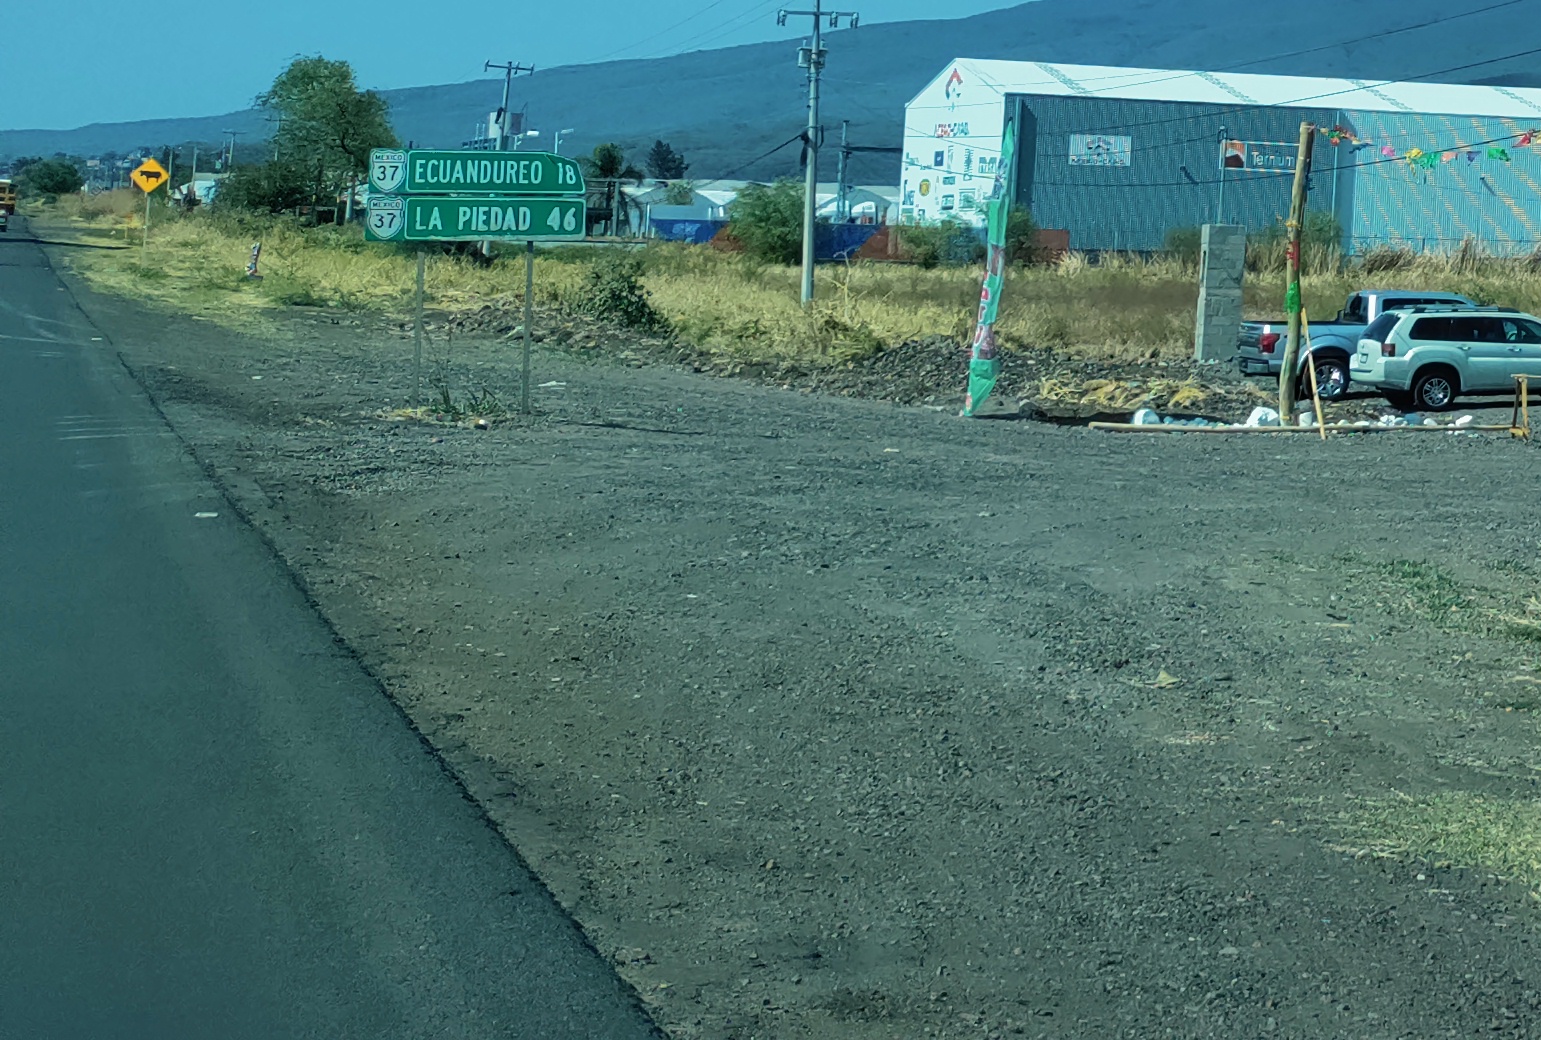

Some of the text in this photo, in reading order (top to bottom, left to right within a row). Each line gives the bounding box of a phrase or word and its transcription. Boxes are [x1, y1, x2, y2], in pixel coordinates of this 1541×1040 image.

[377, 165, 399, 181] 37
[414, 159, 577, 185] ECUANDUREO 18
[374, 212, 397, 229] 37
[415, 206, 576, 232] LA PIEDAD 46
